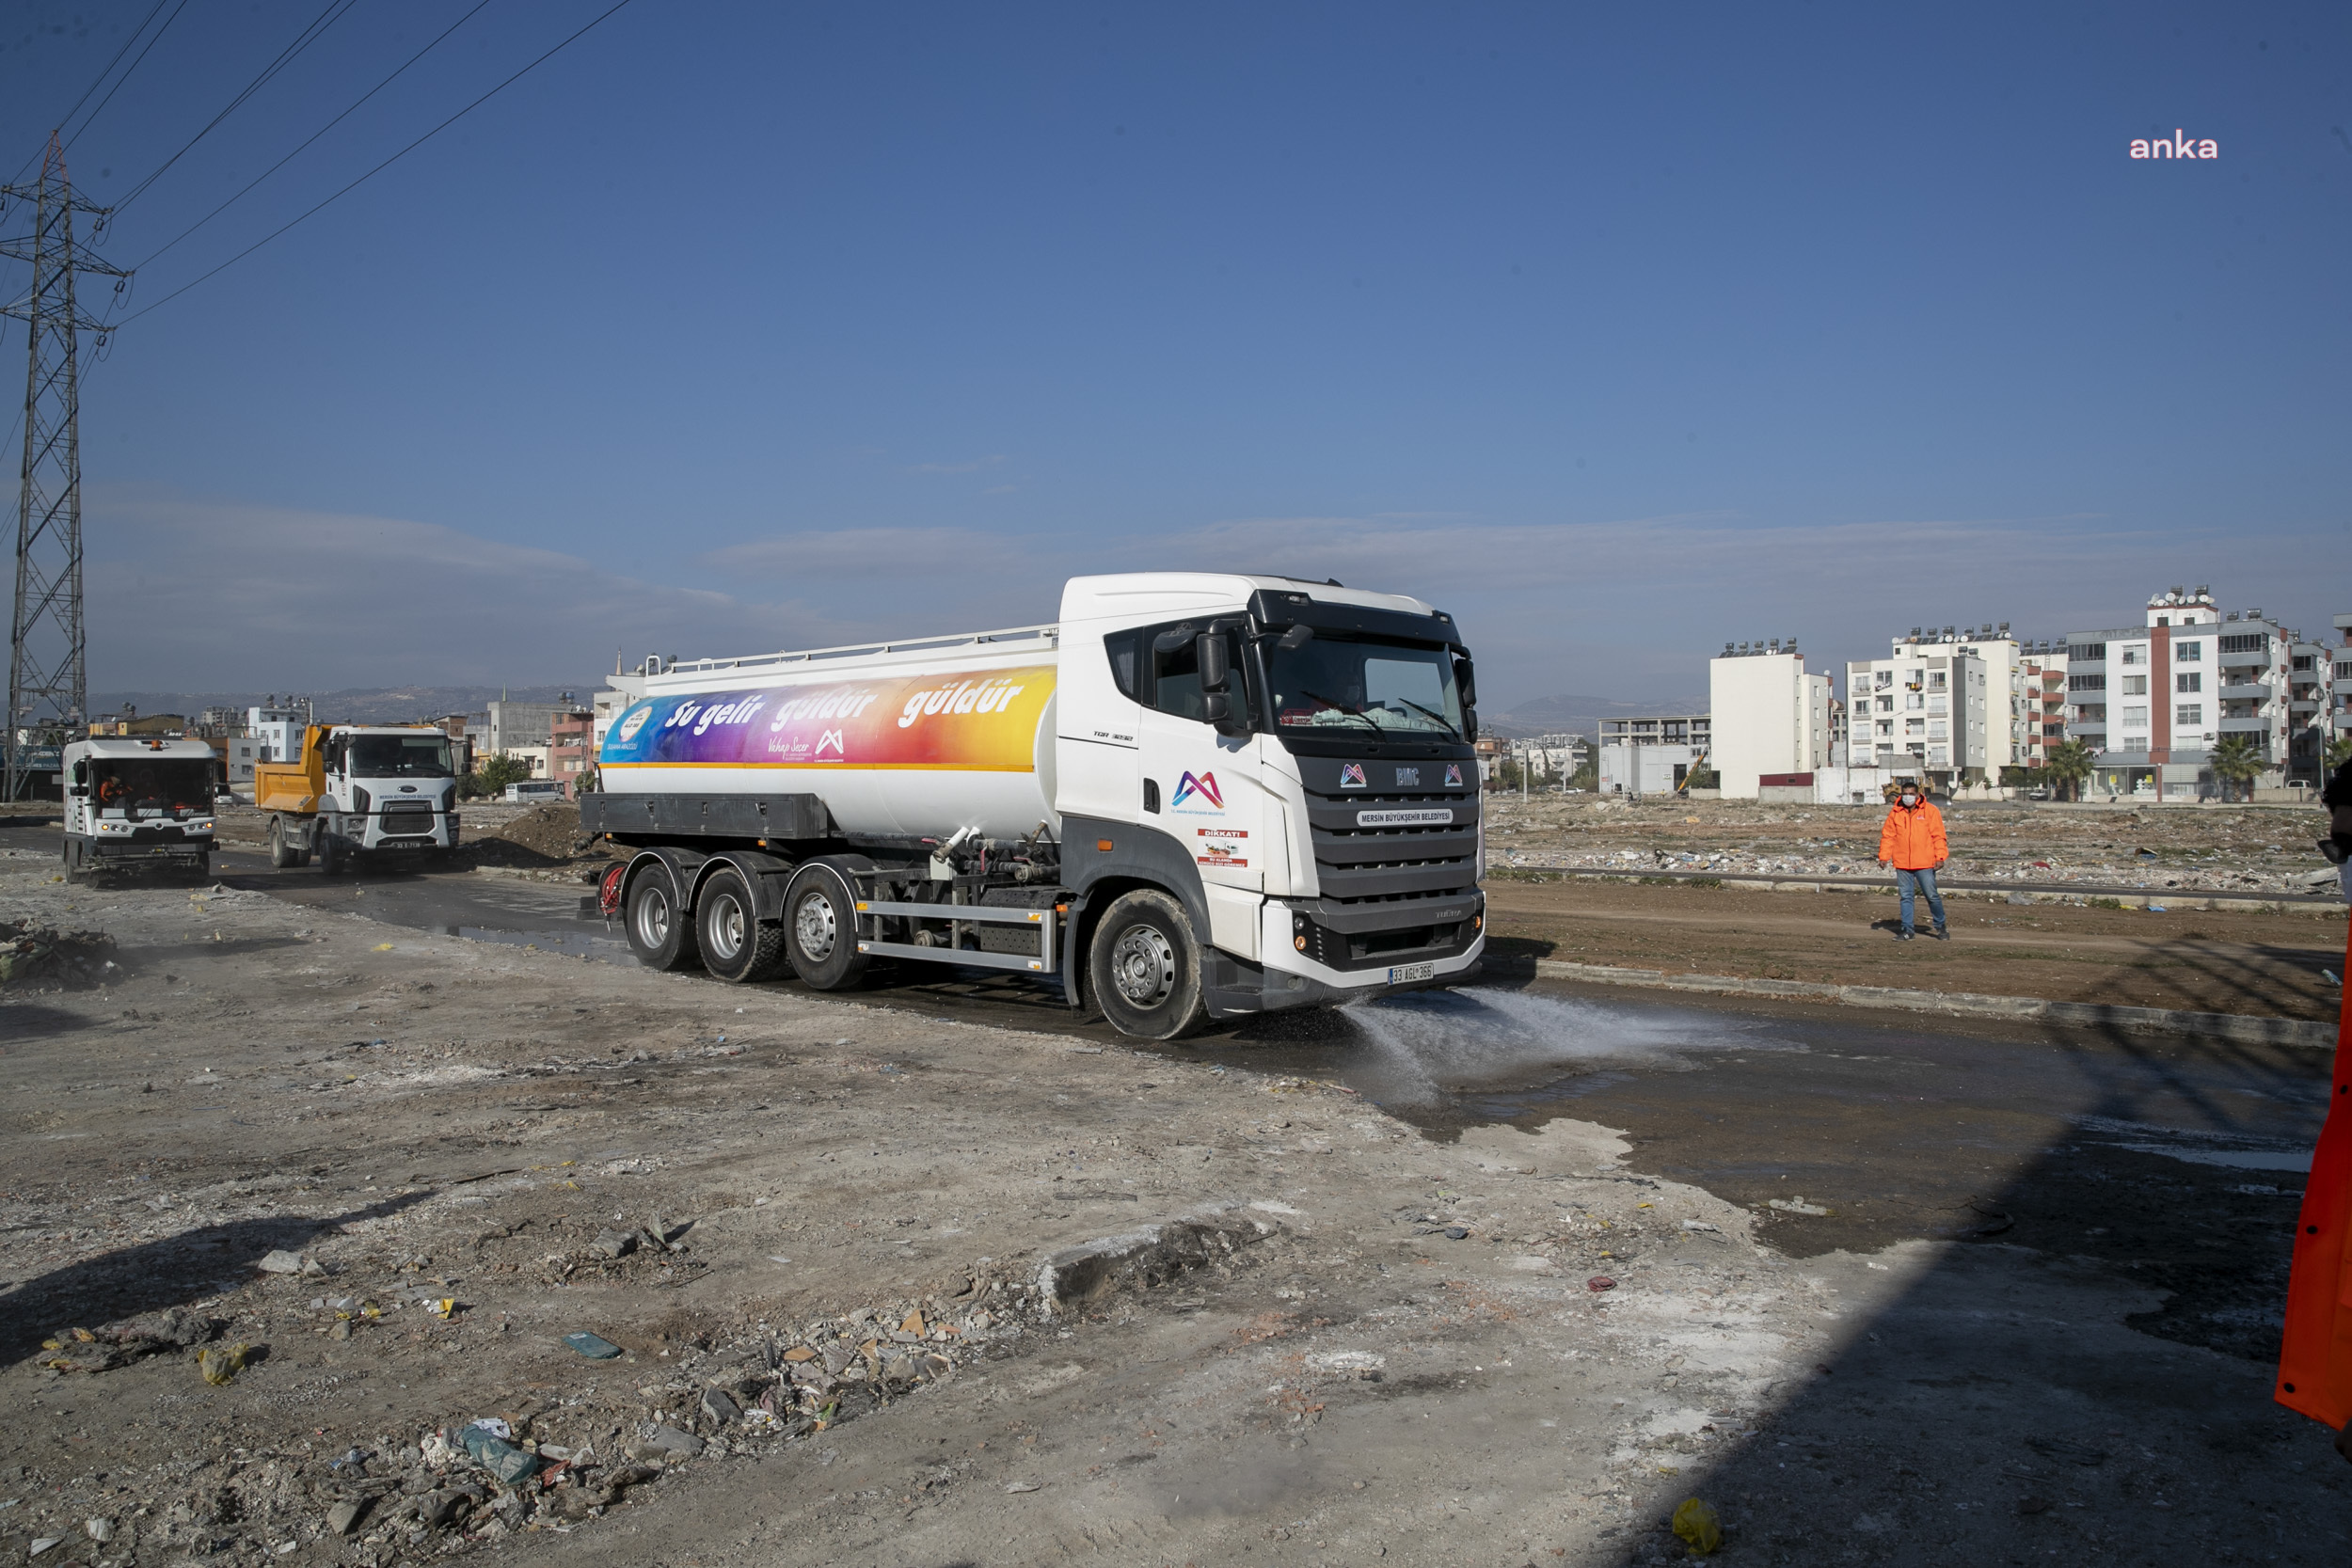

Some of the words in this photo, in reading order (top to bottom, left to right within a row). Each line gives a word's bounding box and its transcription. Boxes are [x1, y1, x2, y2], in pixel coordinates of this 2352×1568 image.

[664, 700, 702, 727] Su
[693, 694, 766, 736] gelir
[771, 684, 879, 732] güldür
[898, 678, 1025, 728] güldür
[768, 736, 789, 760] Vahap
[1396, 767, 1420, 786] BMC
[1361, 813, 1384, 822] MERSİN
[1386, 812, 1421, 823] BÜYÜKŞEHİR
[1422, 810, 1450, 821] BELEDİYESİ
[1393, 969, 1402, 982] 33
[1405, 968, 1417, 980] AGL
[1420, 965, 1432, 978] 366
